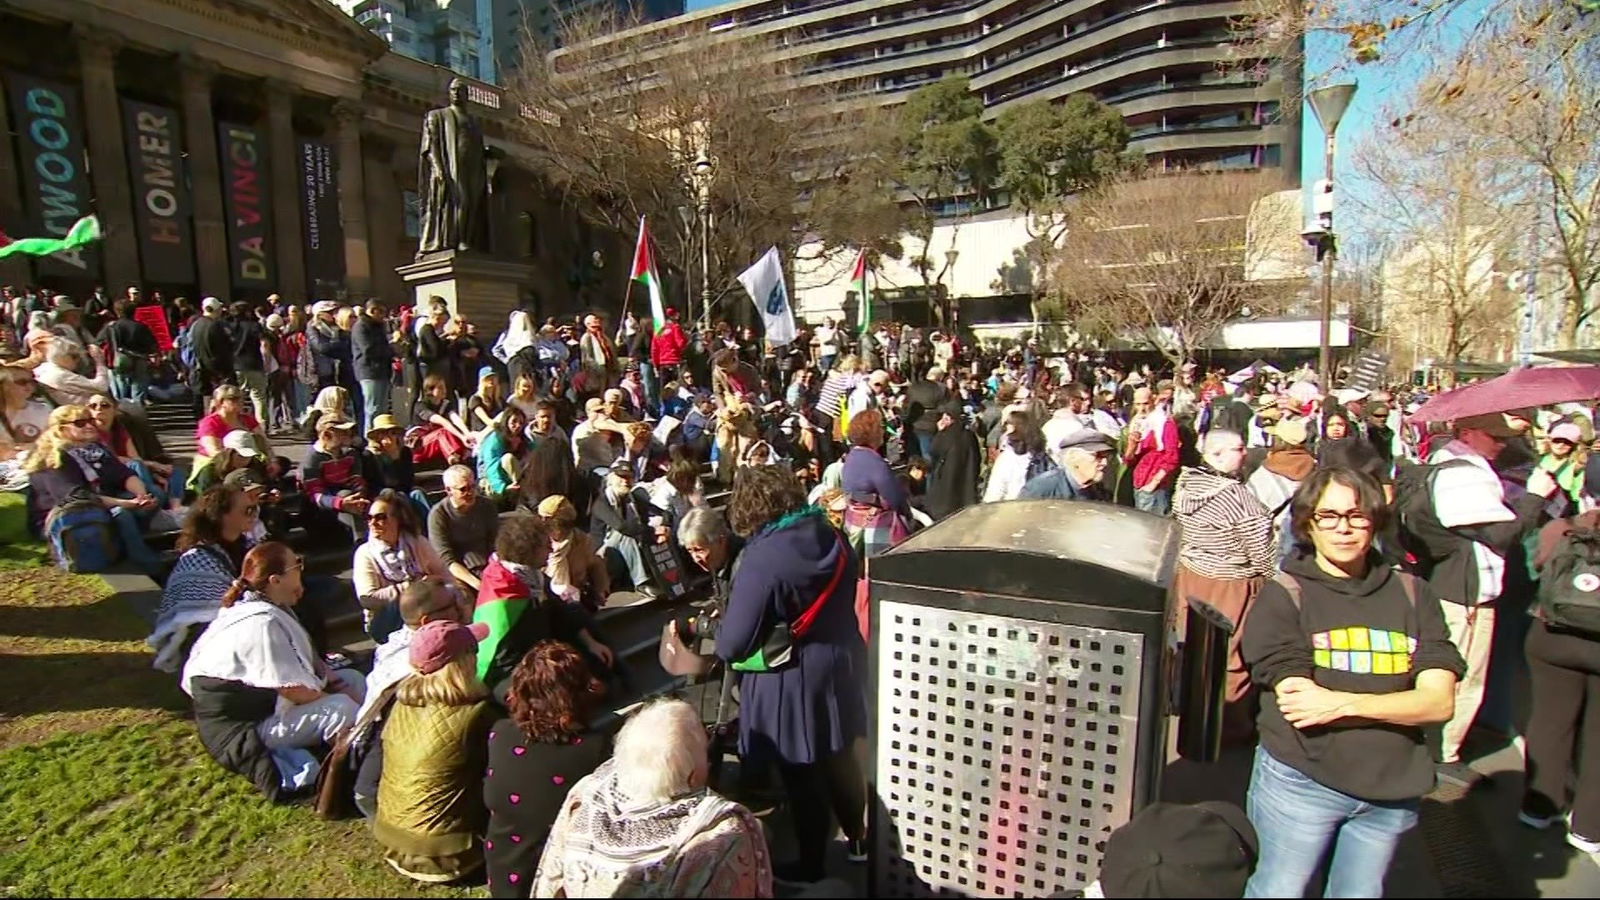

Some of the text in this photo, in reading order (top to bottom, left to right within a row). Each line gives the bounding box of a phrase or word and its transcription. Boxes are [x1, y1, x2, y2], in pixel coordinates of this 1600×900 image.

[137, 111, 181, 244] HOMER
[229, 129, 267, 279] DA VINCI
[304, 143, 319, 249] CELEBRATING 20 YEARS
